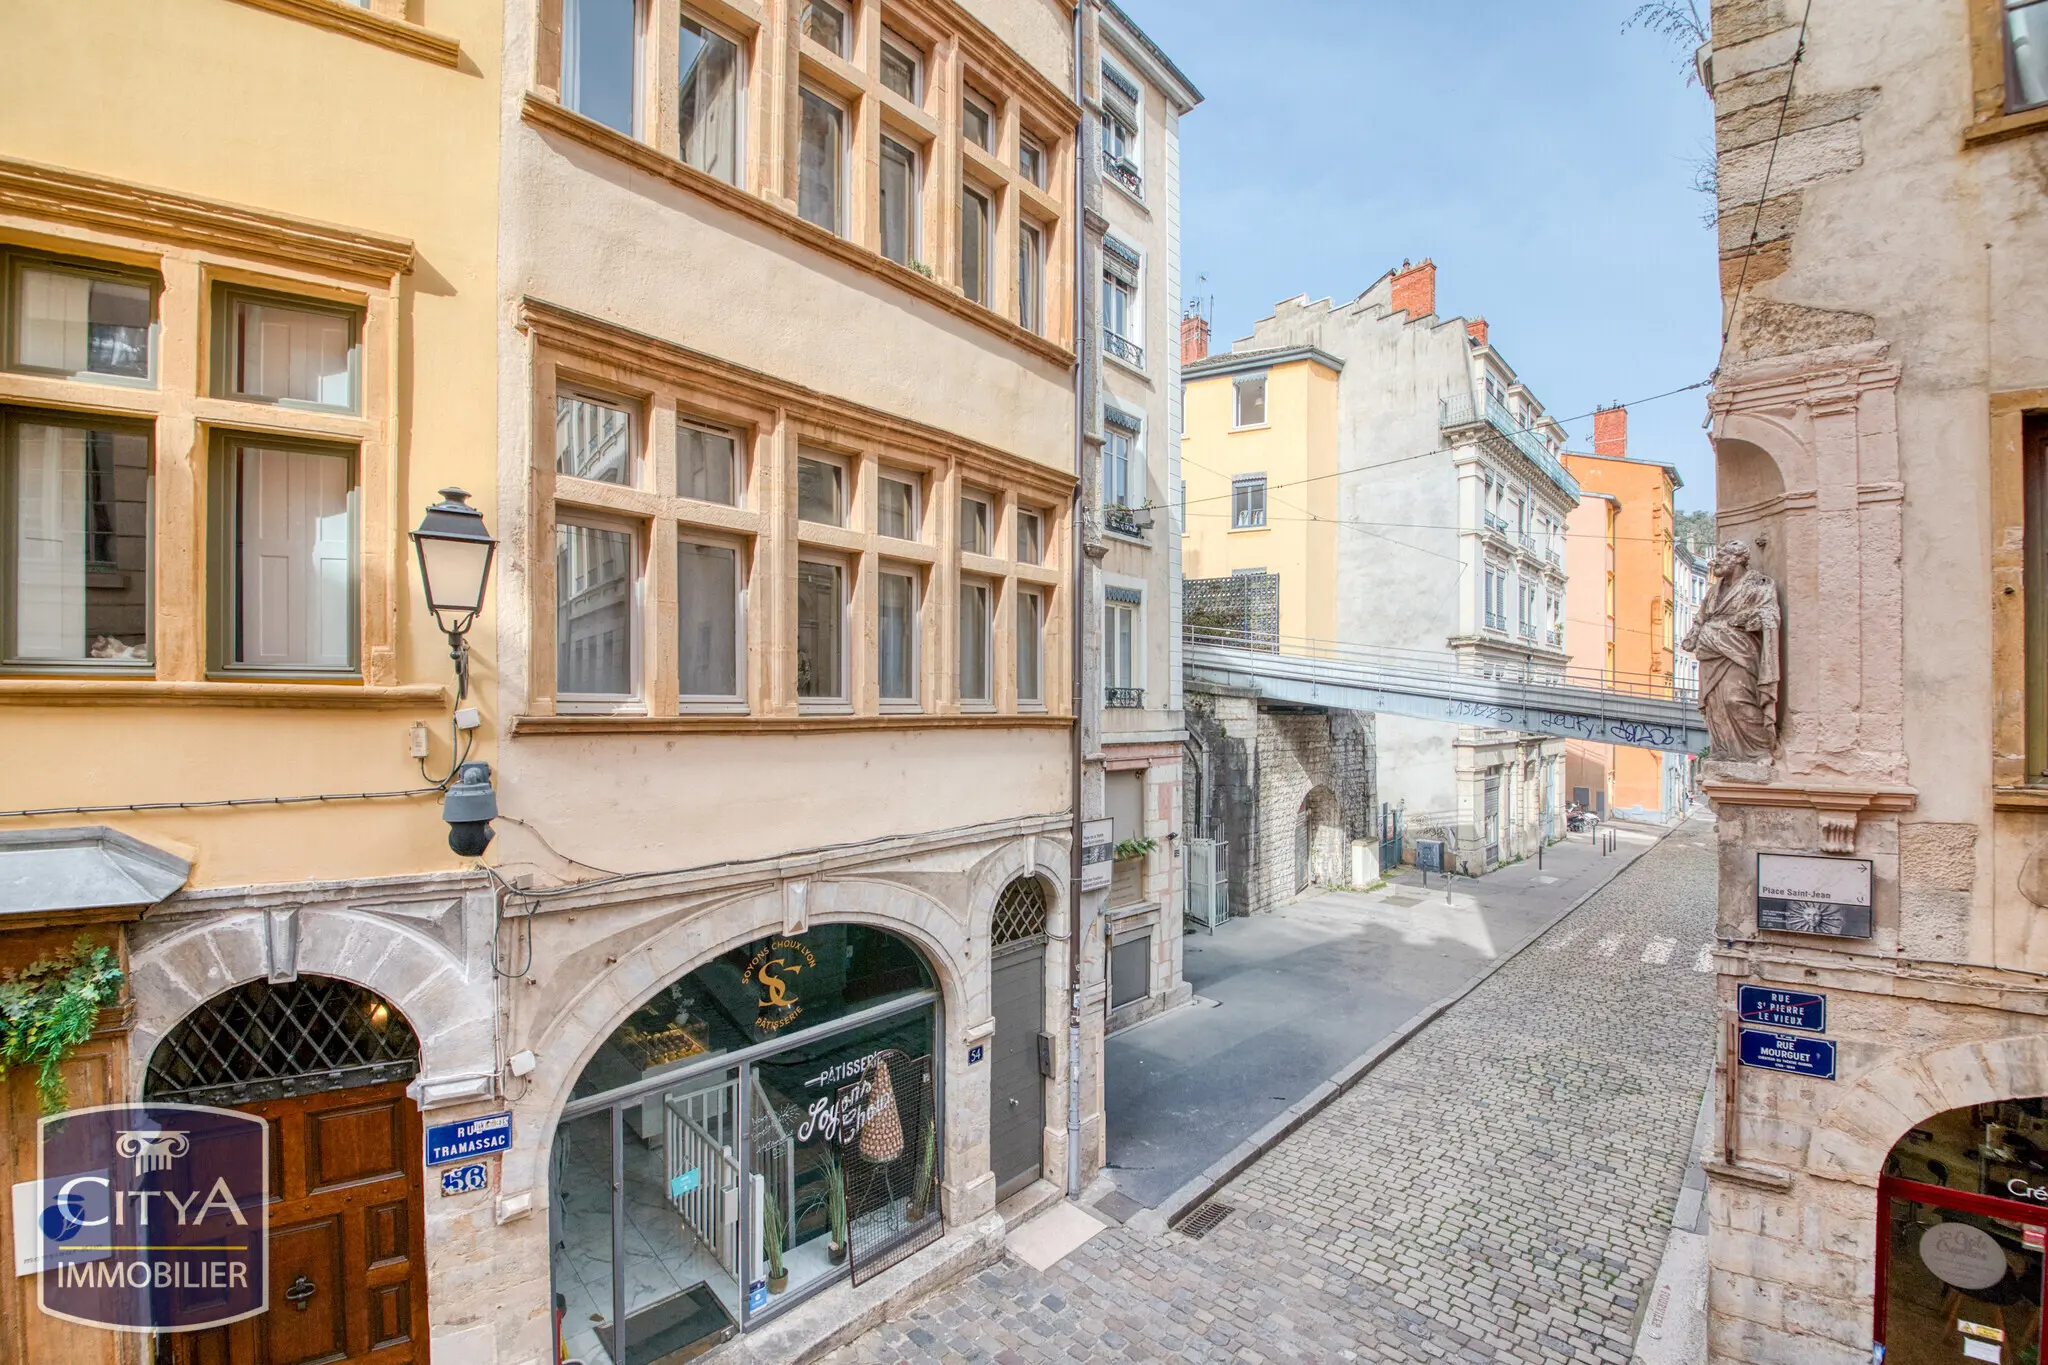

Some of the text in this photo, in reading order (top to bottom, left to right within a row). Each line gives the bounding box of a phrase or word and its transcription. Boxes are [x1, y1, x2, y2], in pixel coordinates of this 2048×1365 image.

[1762, 886, 1831, 899] Place Saint-Jean
[741, 939, 817, 985] SOYONS CHOUX LYON
[1771, 993, 1790, 1003] RUE
[1770, 1003, 1805, 1016] PIERRE
[755, 1005, 803, 1030] PÂTISSERIE
[1758, 1012, 1803, 1026] LE VIEUX
[1776, 1040, 1795, 1051] RUE
[970, 1048, 981, 1062] 54
[1760, 1047, 1811, 1062] MOURGUET
[433, 1134, 506, 1159] TRAMASSAC
[448, 1167, 481, 1191] 56
